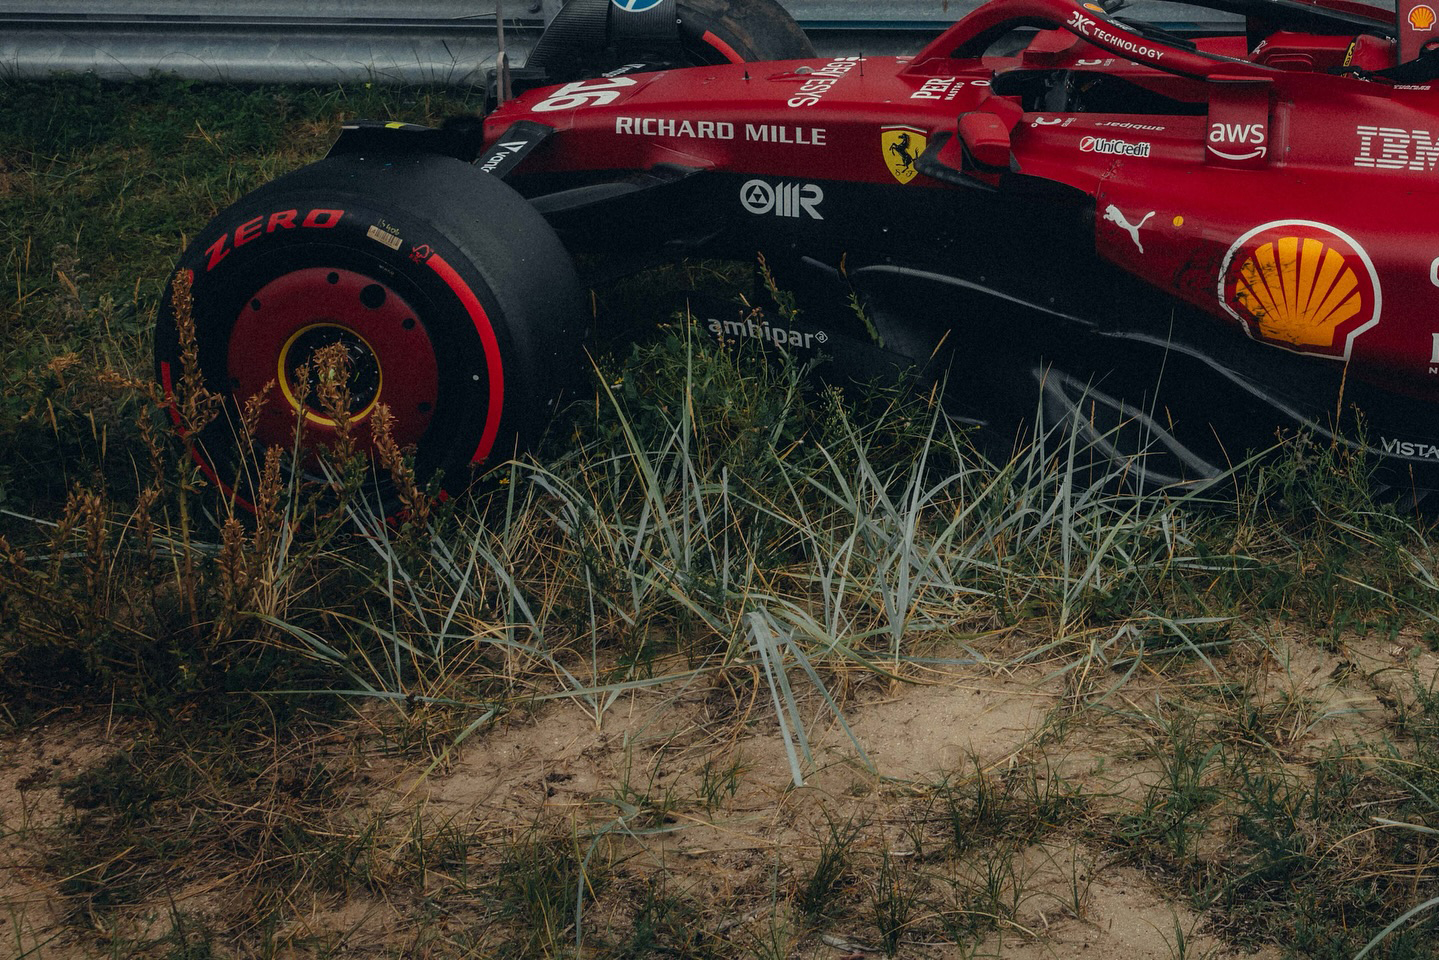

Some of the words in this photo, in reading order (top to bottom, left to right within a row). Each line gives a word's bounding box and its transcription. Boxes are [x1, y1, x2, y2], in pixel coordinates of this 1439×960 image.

[1093, 27, 1164, 60] TECHNOLOGY
[615, 116, 735, 141] RICHARD
[745, 123, 827, 147] MILLE
[1210, 123, 1265, 144] aws
[1094, 139, 1150, 157] UniCredit
[204, 208, 345, 272] ZERO
[707, 318, 814, 349] ambipar
